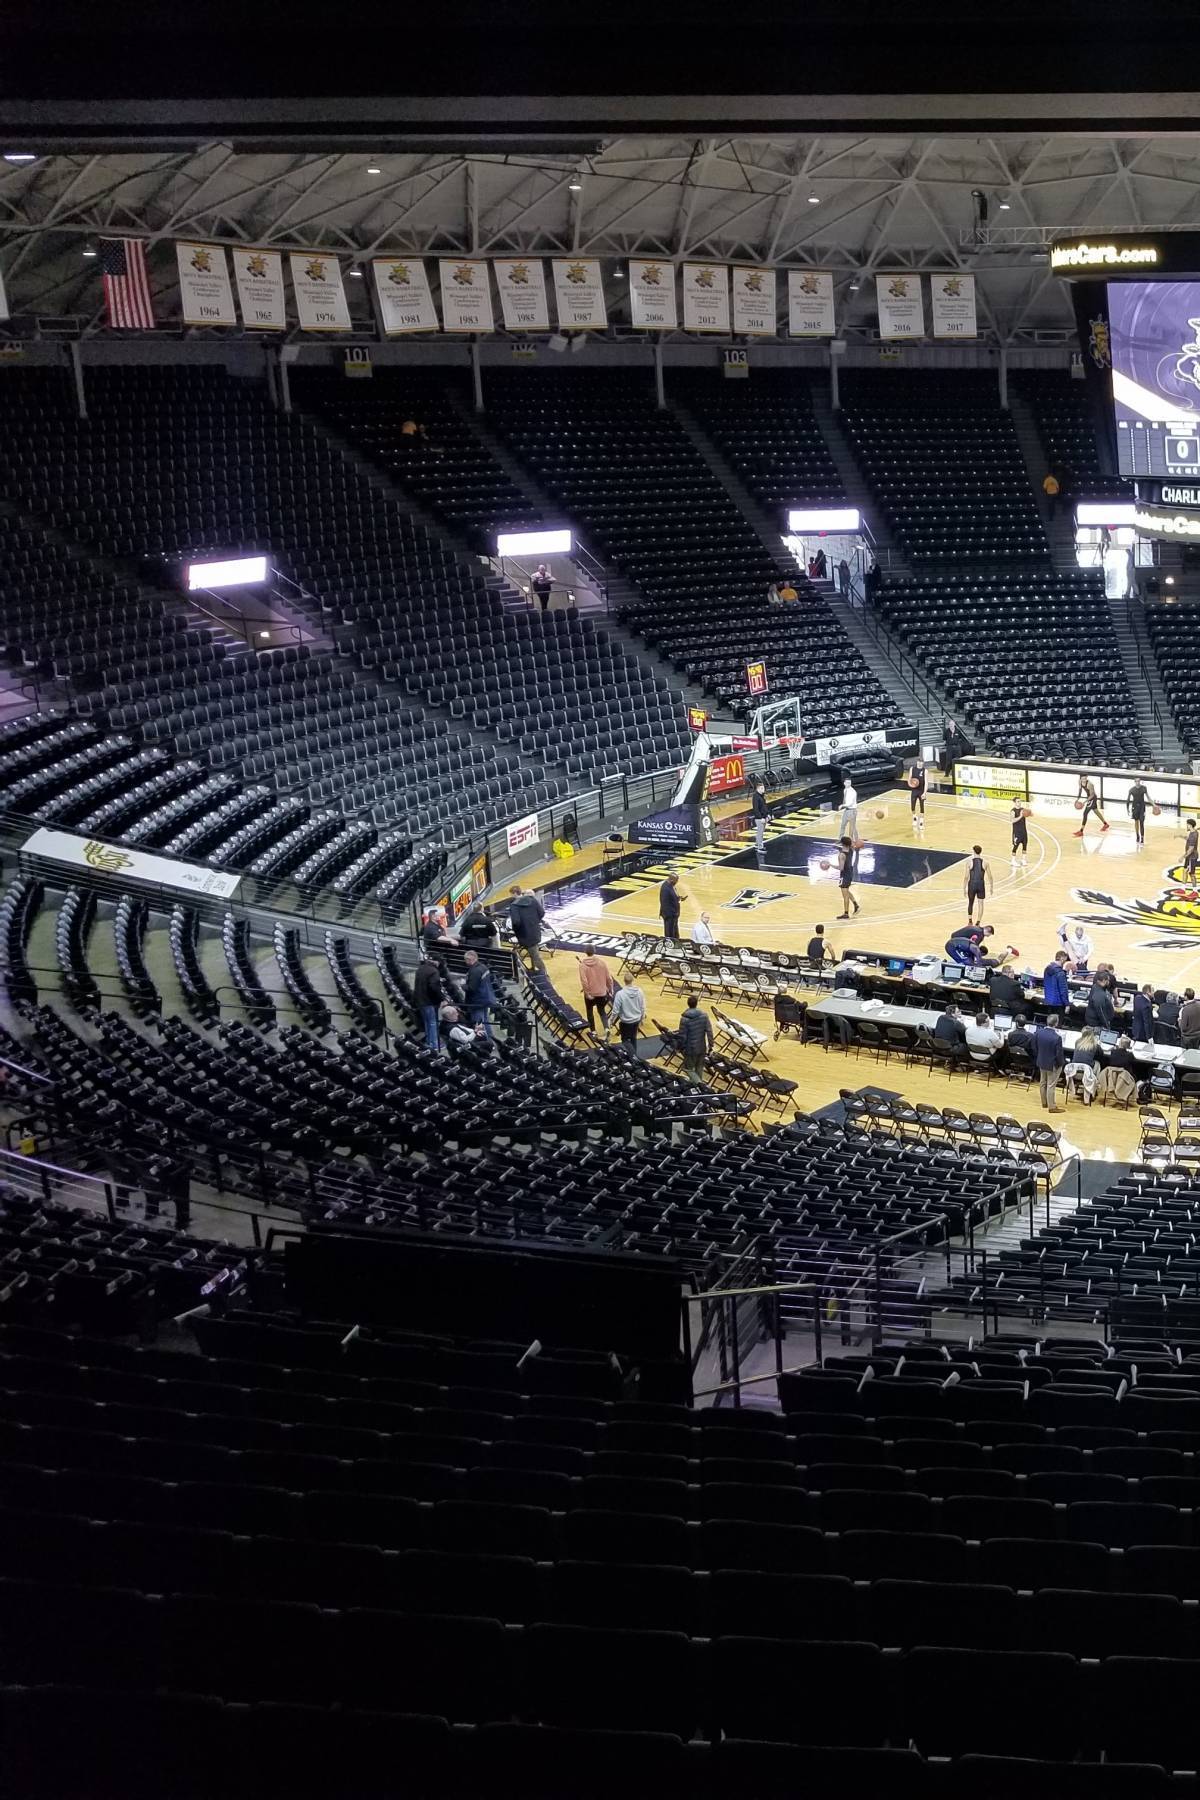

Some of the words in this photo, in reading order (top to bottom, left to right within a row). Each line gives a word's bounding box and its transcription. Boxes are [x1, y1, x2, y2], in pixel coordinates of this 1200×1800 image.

[200, 306, 220, 317] 1964
[316, 313, 335, 322] 1976
[400, 315, 421, 324] 1981
[459, 315, 479, 325] 1983
[517, 313, 535, 322] 1985
[573, 313, 592, 322] 1987
[645, 313, 664, 322] 2006
[698, 316, 716, 325] 2012
[747, 319, 764, 328] 2014
[803, 321, 821, 329] 2015
[893, 324, 911, 332] 2016
[946, 323, 963, 331] 2017
[344, 348, 370, 362] 101
[724, 351, 746, 364] 103
[1177, 441, 1188, 459] 0
[638, 821, 663, 829] KANSAS
[674, 823, 692, 831] STAR
[510, 821, 537, 848] ESPN
